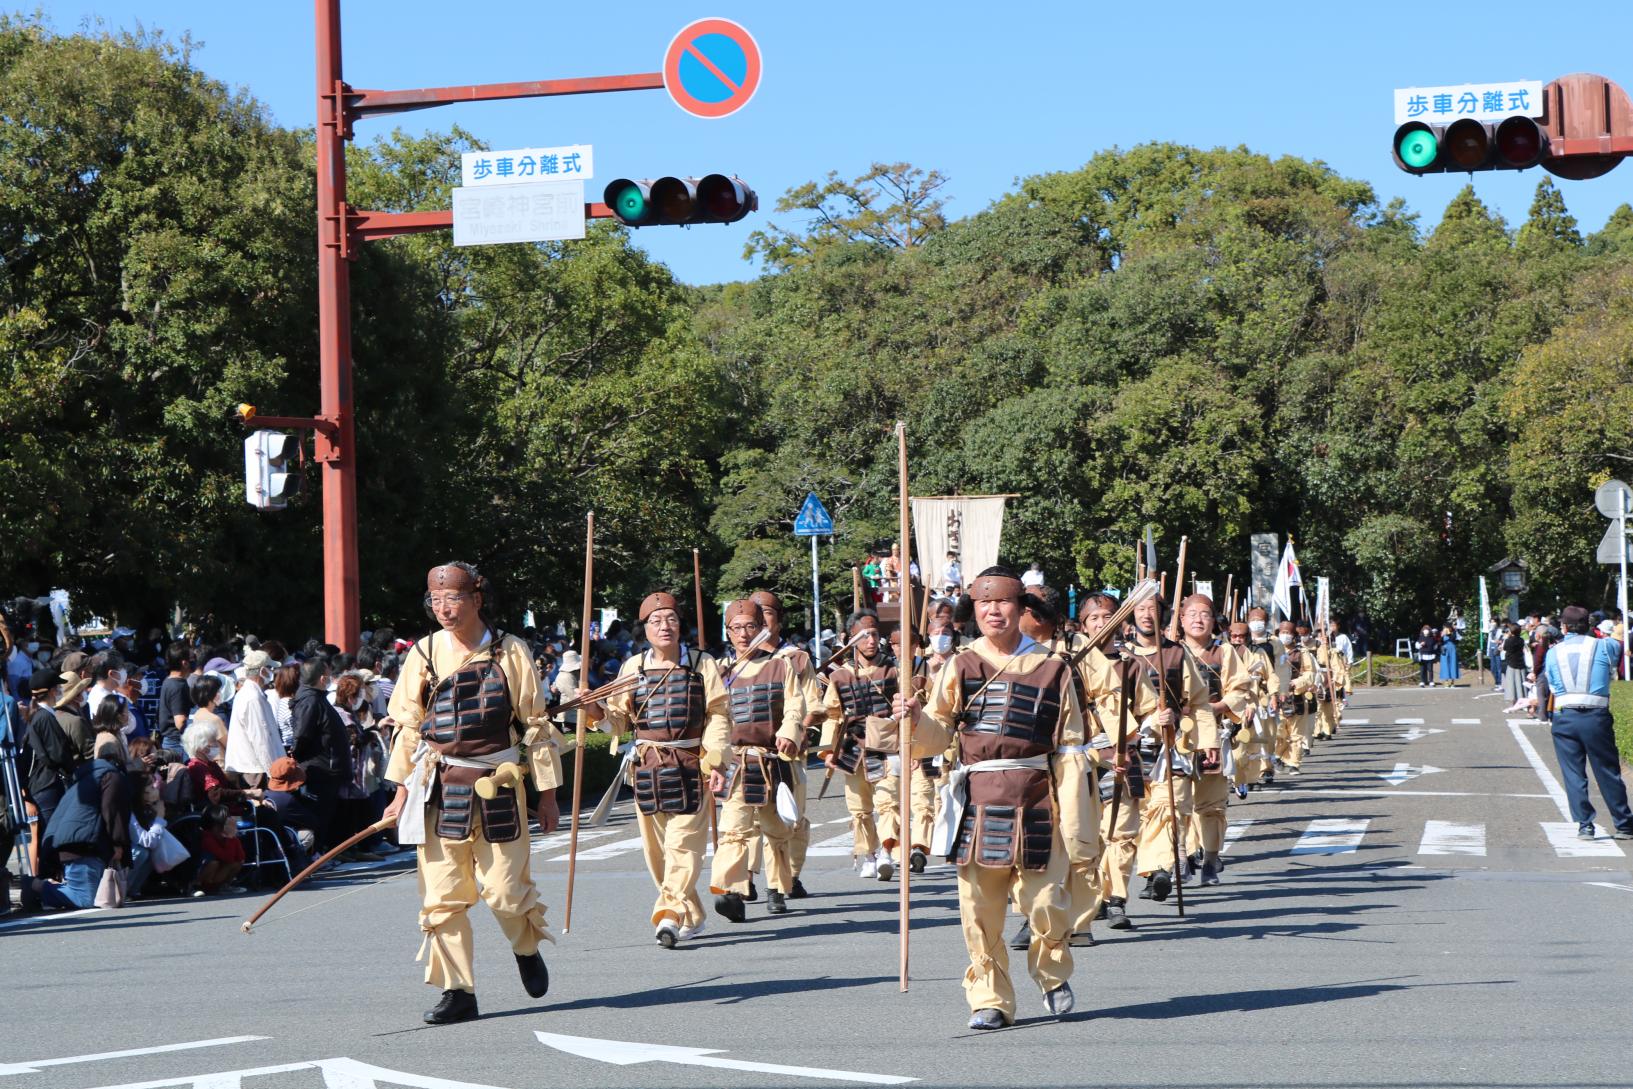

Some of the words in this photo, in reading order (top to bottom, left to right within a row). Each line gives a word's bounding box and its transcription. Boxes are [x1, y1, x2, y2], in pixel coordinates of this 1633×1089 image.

[1407, 89, 1530, 117] 歩車分離式
[473, 152, 582, 180] 歩車分離式
